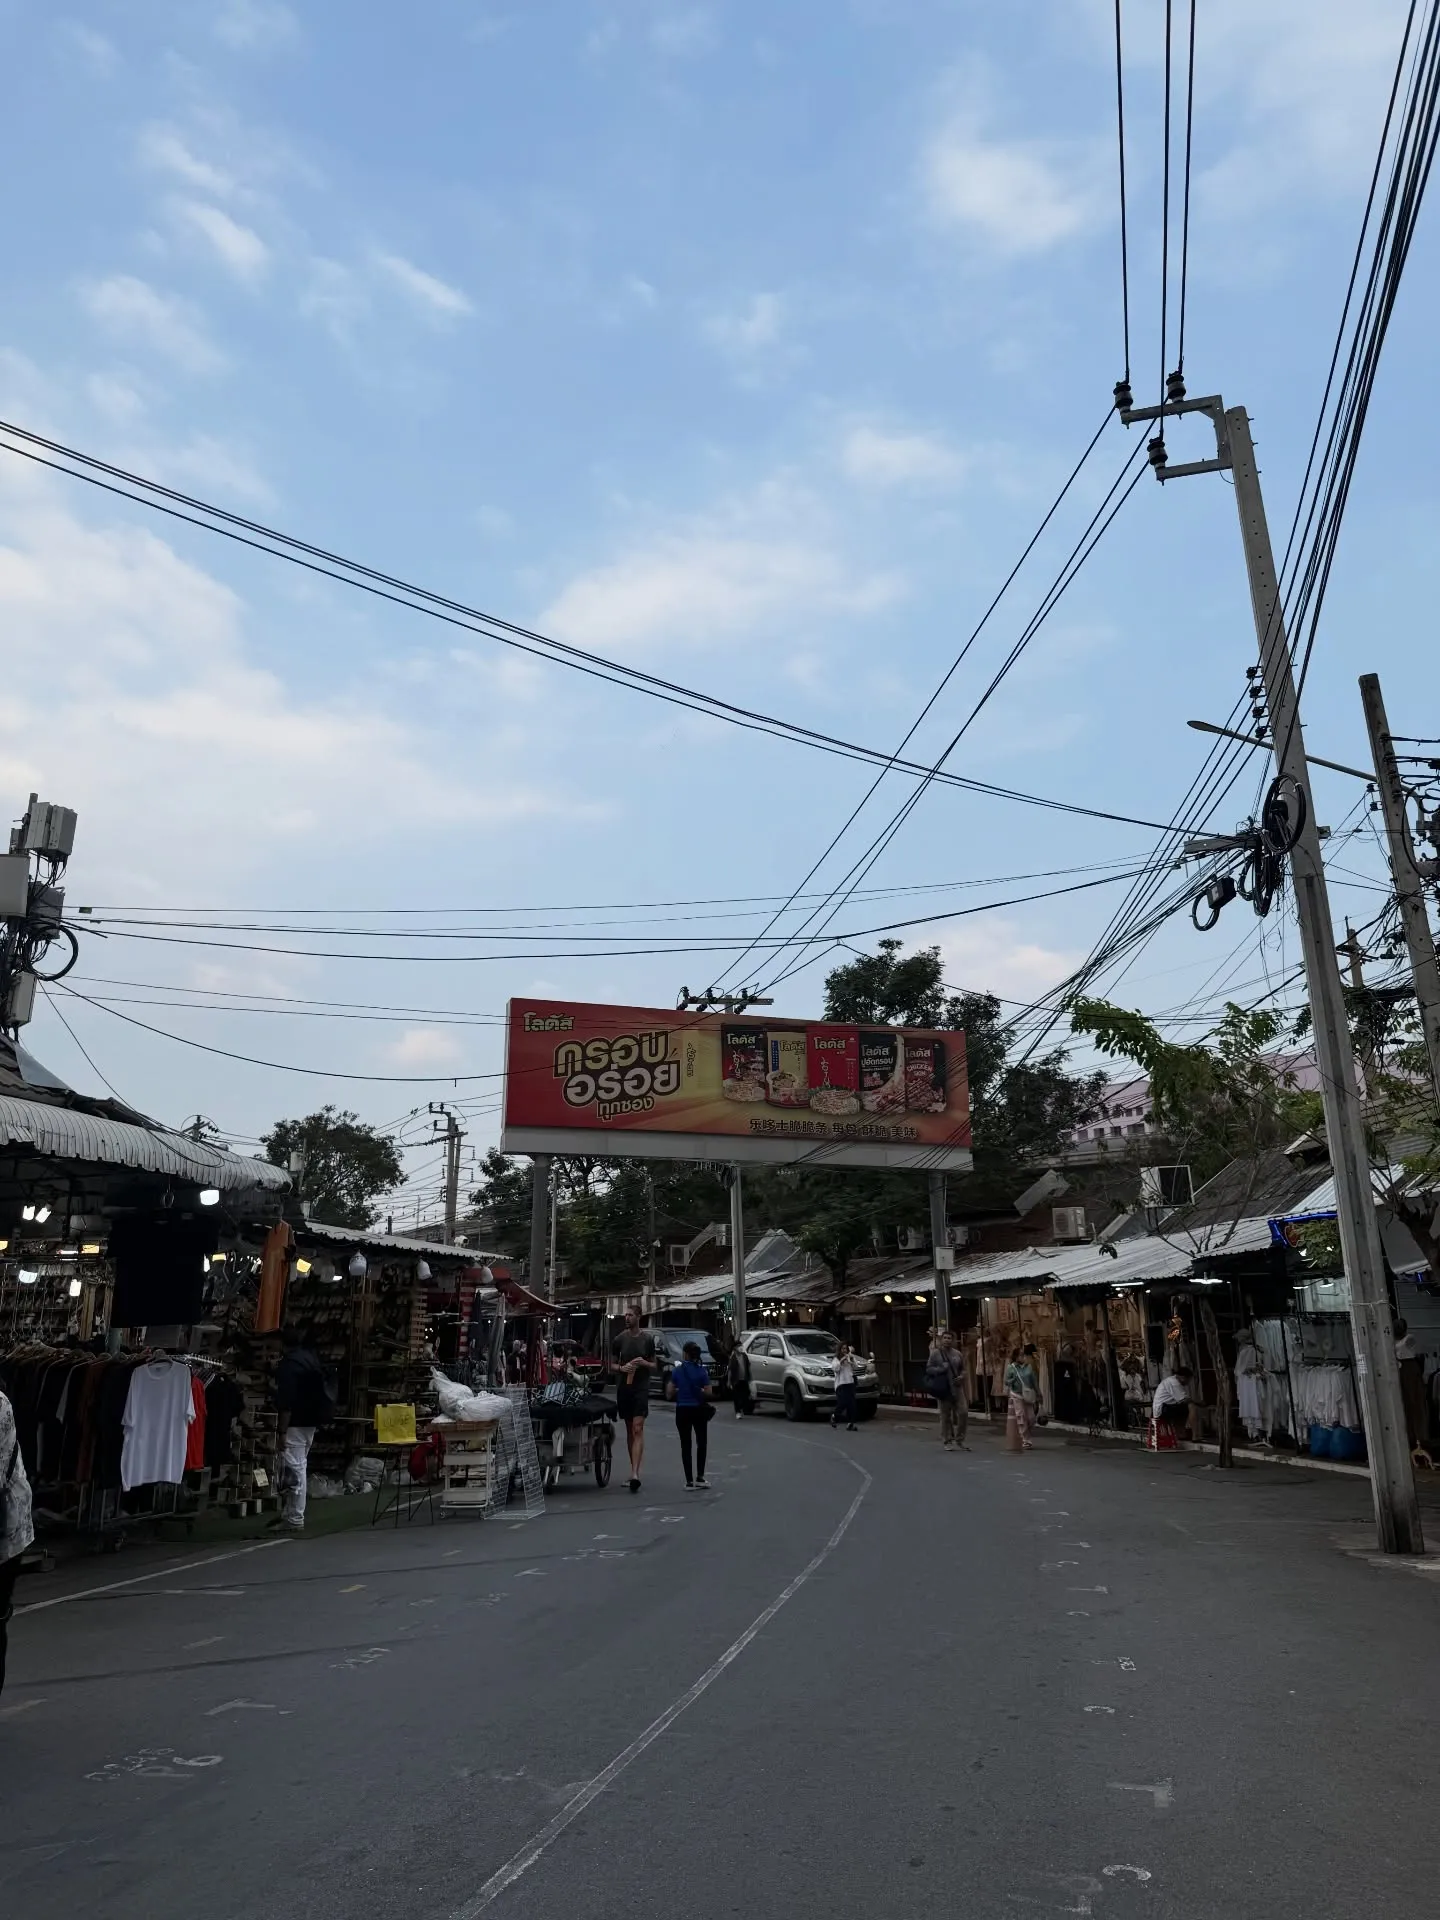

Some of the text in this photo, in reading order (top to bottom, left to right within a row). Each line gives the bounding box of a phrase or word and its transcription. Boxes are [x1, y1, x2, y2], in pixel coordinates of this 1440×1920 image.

[523, 1011, 575, 1032] โลตัส
[726, 1033, 757, 1046] โลตัส
[813, 1036, 846, 1050] โลตัส
[556, 1032, 668, 1076] กรอบ
[861, 1044, 890, 1057] โลตัส
[905, 1047, 931, 1058] โลตัส
[906, 1063, 933, 1072] CHICKEN
[565, 1061, 679, 1105] อร่อย
[598, 1097, 654, 1120] ทุกซอง
[890, 1126, 918, 1139] 美味
